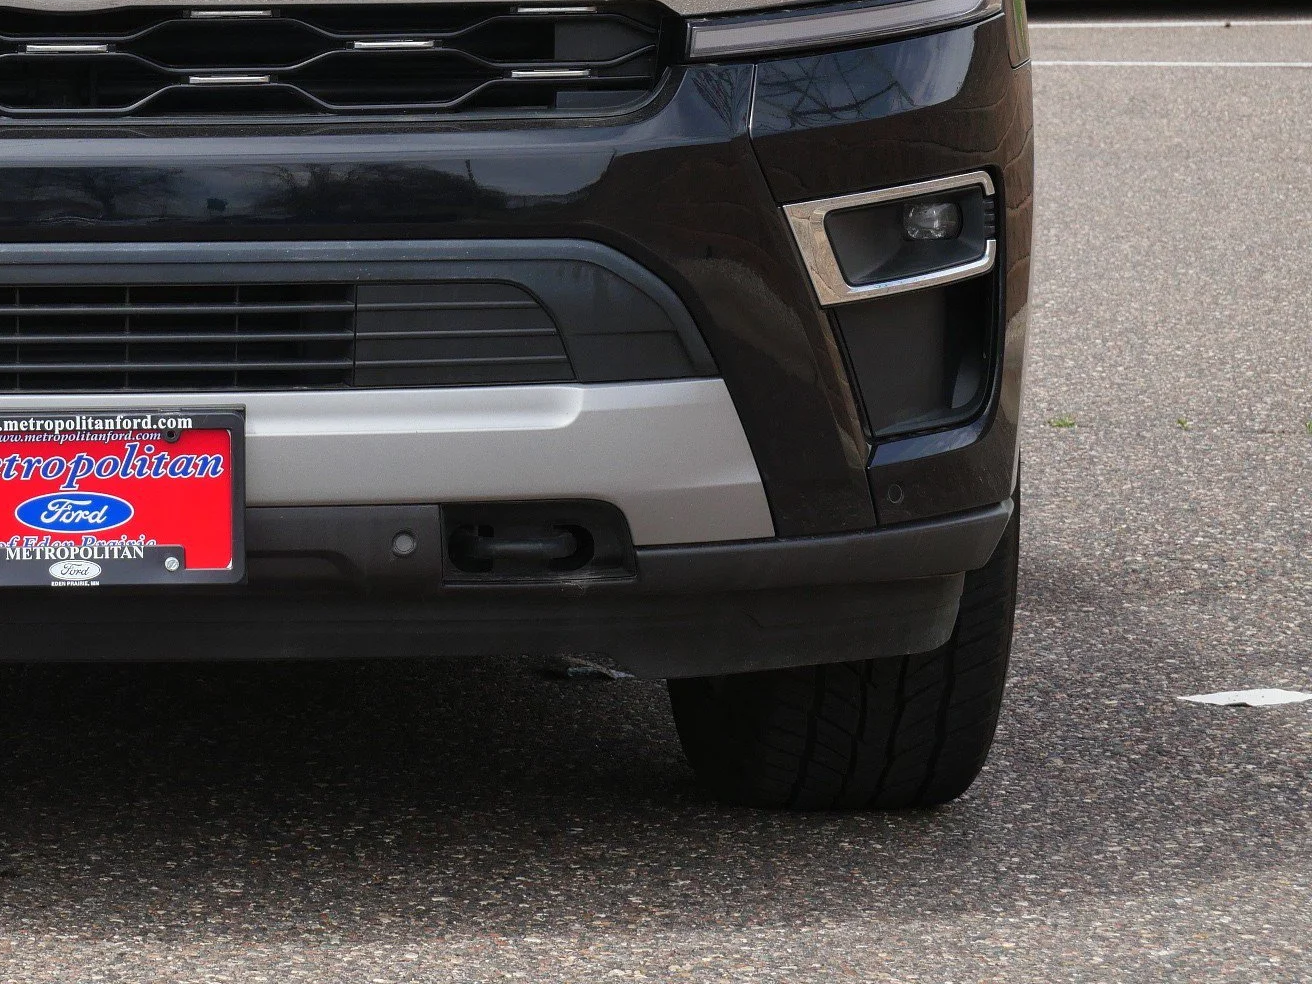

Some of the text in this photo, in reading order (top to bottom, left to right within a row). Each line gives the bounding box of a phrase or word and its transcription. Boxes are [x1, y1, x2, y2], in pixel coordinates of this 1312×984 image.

[40, 498, 107, 524] Ford
[5, 545, 145, 561] METROPOLITAN
[60, 563, 90, 576] Ford
